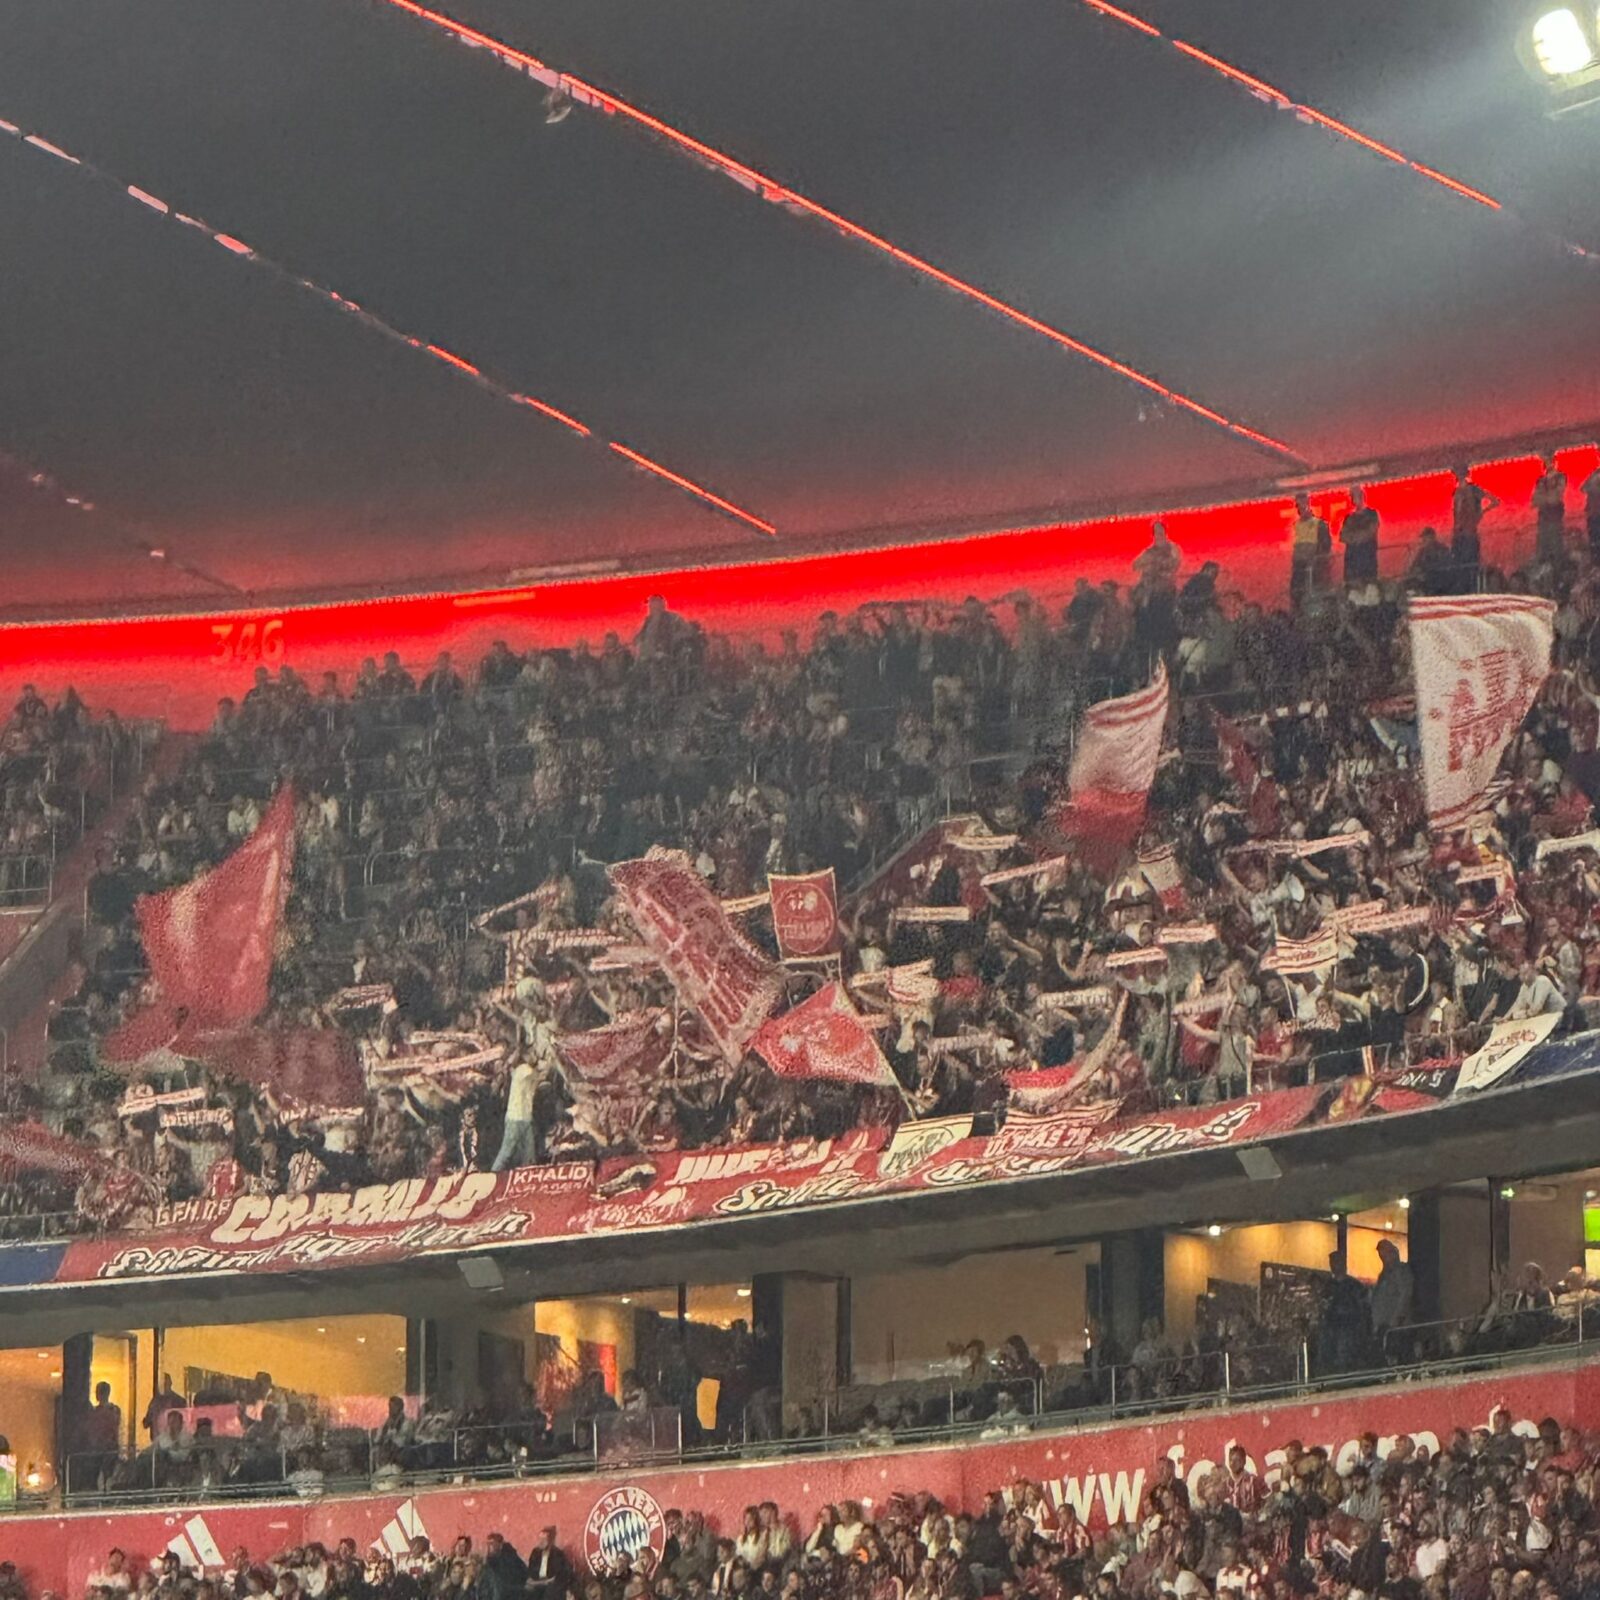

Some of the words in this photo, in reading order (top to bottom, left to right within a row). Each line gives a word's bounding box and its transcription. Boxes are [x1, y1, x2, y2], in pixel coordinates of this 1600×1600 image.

[210, 619, 285, 665] 346
[513, 1165, 588, 1185] KHALID
[590, 1510, 605, 1535] FC
[604, 1488, 661, 1531] BAYERN
